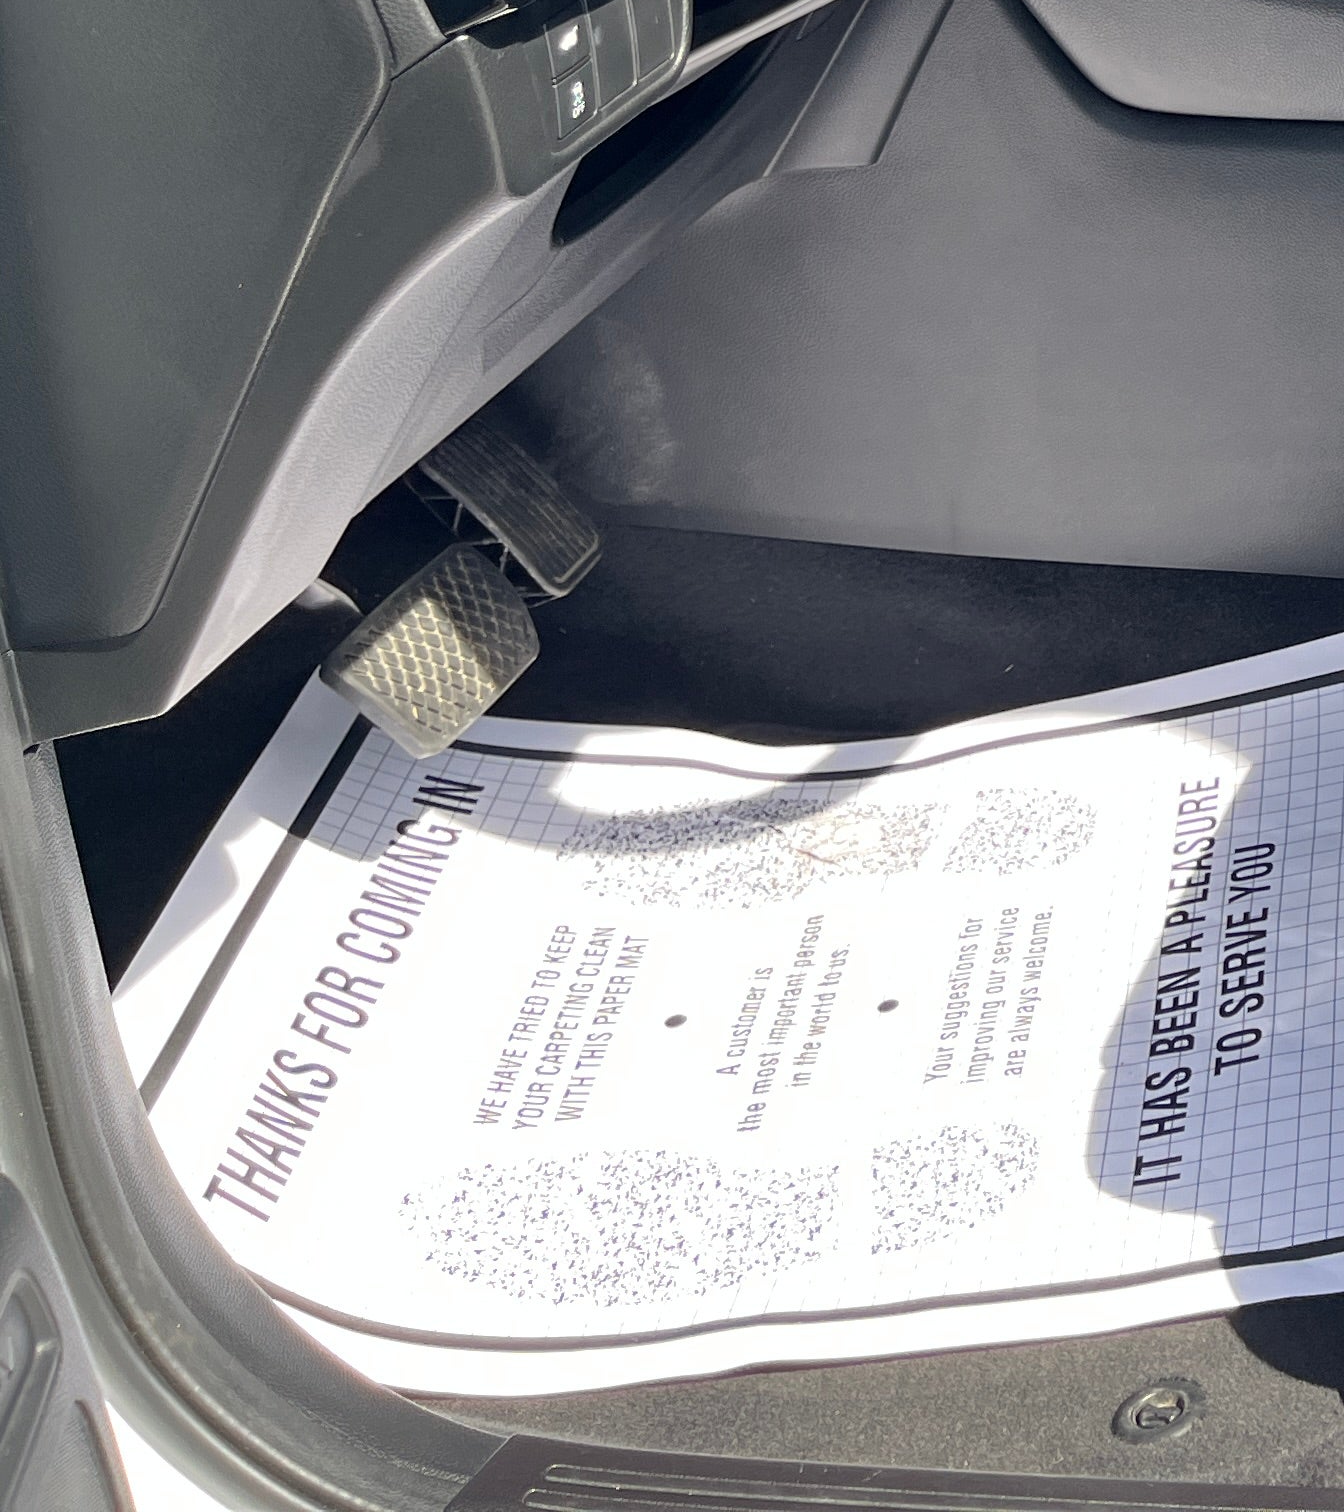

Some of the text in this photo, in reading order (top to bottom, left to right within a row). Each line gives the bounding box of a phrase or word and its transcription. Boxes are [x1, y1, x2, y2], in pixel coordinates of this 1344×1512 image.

[200, 774, 487, 1234] THANKS FOR COMING IN
[471, 925, 581, 1127] WE HAVE TRIED TO KEEP
[510, 926, 617, 1133] YOUR CARPETING CLEAN
[553, 934, 652, 1125] WITH THIS PAPER MAT
[715, 966, 774, 1074] A customer is
[734, 914, 827, 1132] the most important person
[784, 942, 852, 1087] in the world to us.
[922, 917, 984, 1083] Your suggestions for
[959, 907, 1020, 1084] improving our service
[1001, 905, 1055, 1075] are always welcome.
[1131, 776, 1220, 1186] IT HAS BEEN A PLEASURE
[1211, 842, 1276, 1076] TO SERVE YOU
